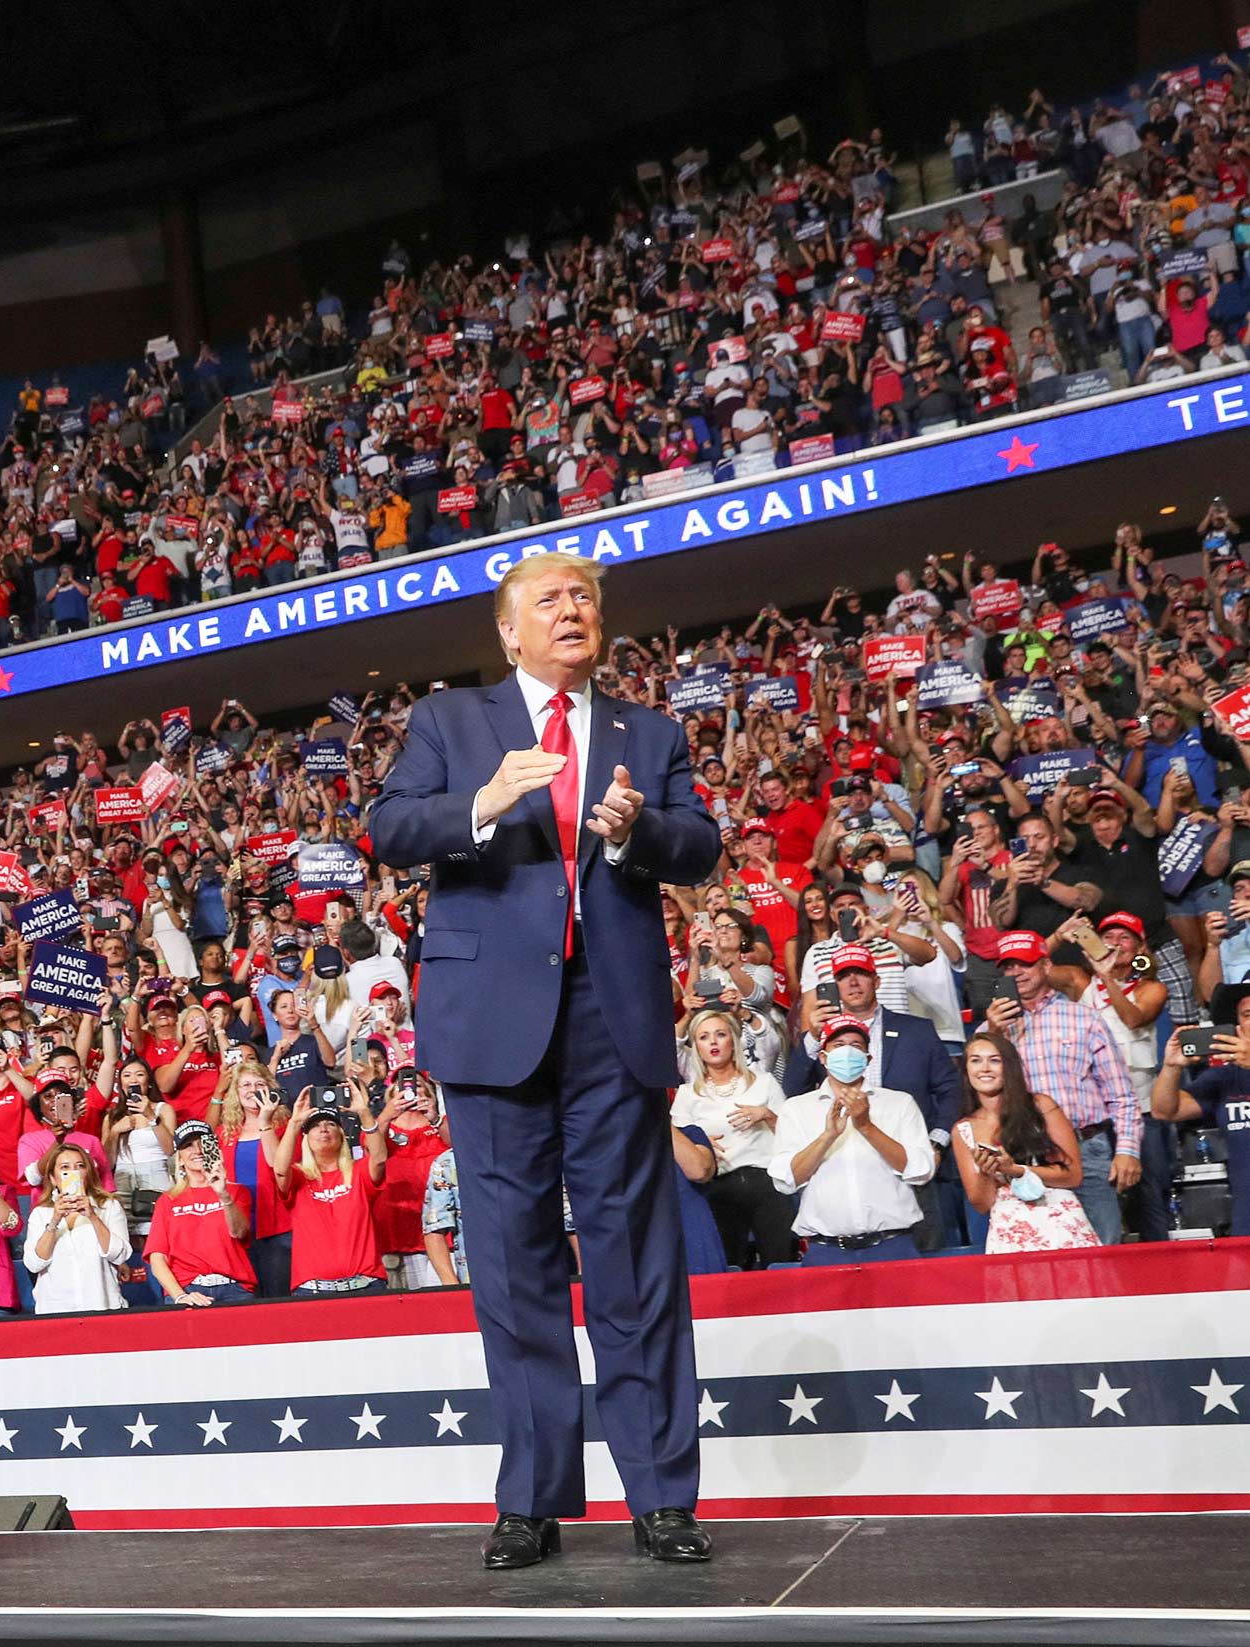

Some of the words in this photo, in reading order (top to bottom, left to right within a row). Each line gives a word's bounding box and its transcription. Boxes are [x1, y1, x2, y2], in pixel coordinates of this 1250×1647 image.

[101, 616, 221, 669] MAKE
[245, 564, 460, 638] AMERICA
[680, 468, 880, 542] AGAIN!
[976, 592, 1017, 606] AMERICA
[1070, 610, 1124, 631] AMERICA
[879, 641, 905, 652] MAKE
[867, 651, 922, 666] AMERICA
[933, 665, 963, 677] MAKE
[682, 679, 705, 689] MAKE
[760, 682, 781, 691] MAKE
[918, 672, 983, 691] AMERICA
[670, 685, 720, 702] AMERICA
[918, 688, 950, 701] GREAT
[196, 750, 230, 767] AMERICA
[305, 754, 347, 763] AMERICA
[1039, 758, 1071, 770] MAKE
[98, 798, 143, 810] AMERICA
[98, 809, 122, 818] GREAT
[744, 817, 766, 829] USA
[261, 838, 283, 847] MAKE
[317, 851, 345, 861] MAKE
[1176, 842, 1202, 873] MAKE
[301, 860, 362, 872] AMERICA
[301, 873, 332, 883] GREAT
[333, 871, 364, 883] AGAIN
[32, 898, 58, 915] MAKE
[755, 895, 784, 908] 2020
[20, 903, 78, 934] AMERICA
[23, 925, 53, 943] GREAT
[54, 914, 82, 932] AGAIN
[56, 953, 88, 970] MAKE
[33, 963, 103, 989] AMERICA
[30, 979, 67, 996] GREAT
[67, 989, 100, 1007] AGAIN
[280, 1052, 309, 1065] UMP
